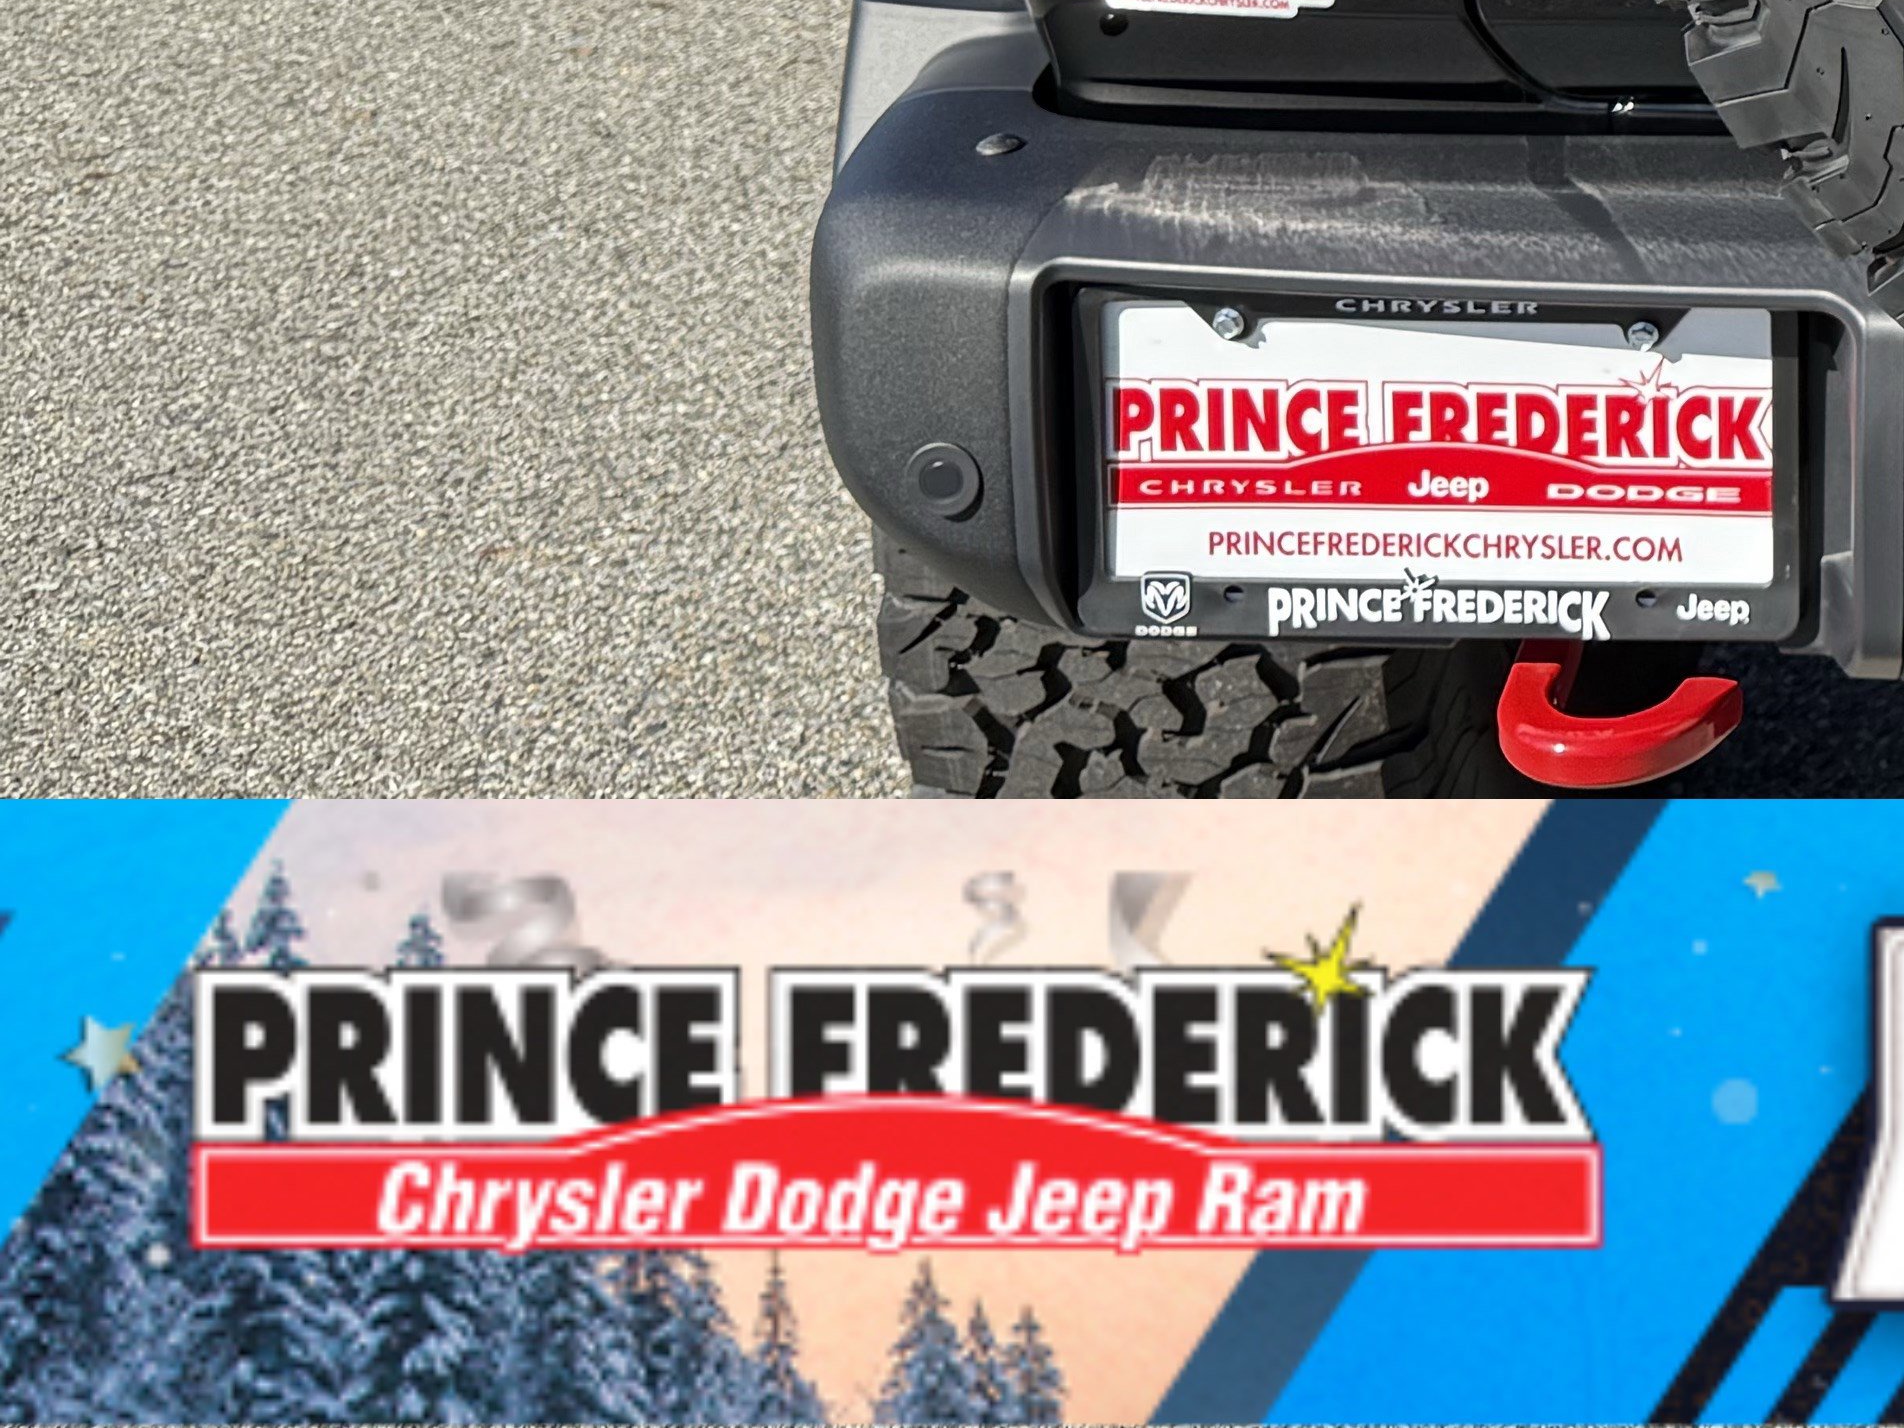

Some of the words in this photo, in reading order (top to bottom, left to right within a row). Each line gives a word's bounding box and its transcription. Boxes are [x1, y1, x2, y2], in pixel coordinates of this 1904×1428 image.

[1334, 297, 1539, 316] CHRYSLER
[1119, 384, 1361, 455] PRINCE
[1392, 388, 1771, 462] FREDERICK
[1138, 478, 1363, 498] CHRYSLER
[1407, 469, 1490, 505] Jeep
[1546, 482, 1742, 505] DODGE
[1208, 530, 1684, 565] PRINCEFREDERICKCHRYSLER.COM
[1267, 585, 1403, 636] PRINCE
[1412, 586, 1611, 641] FREDERICK
[1677, 593, 1747, 626] Jeep
[1135, 625, 1198, 638] DODGE
